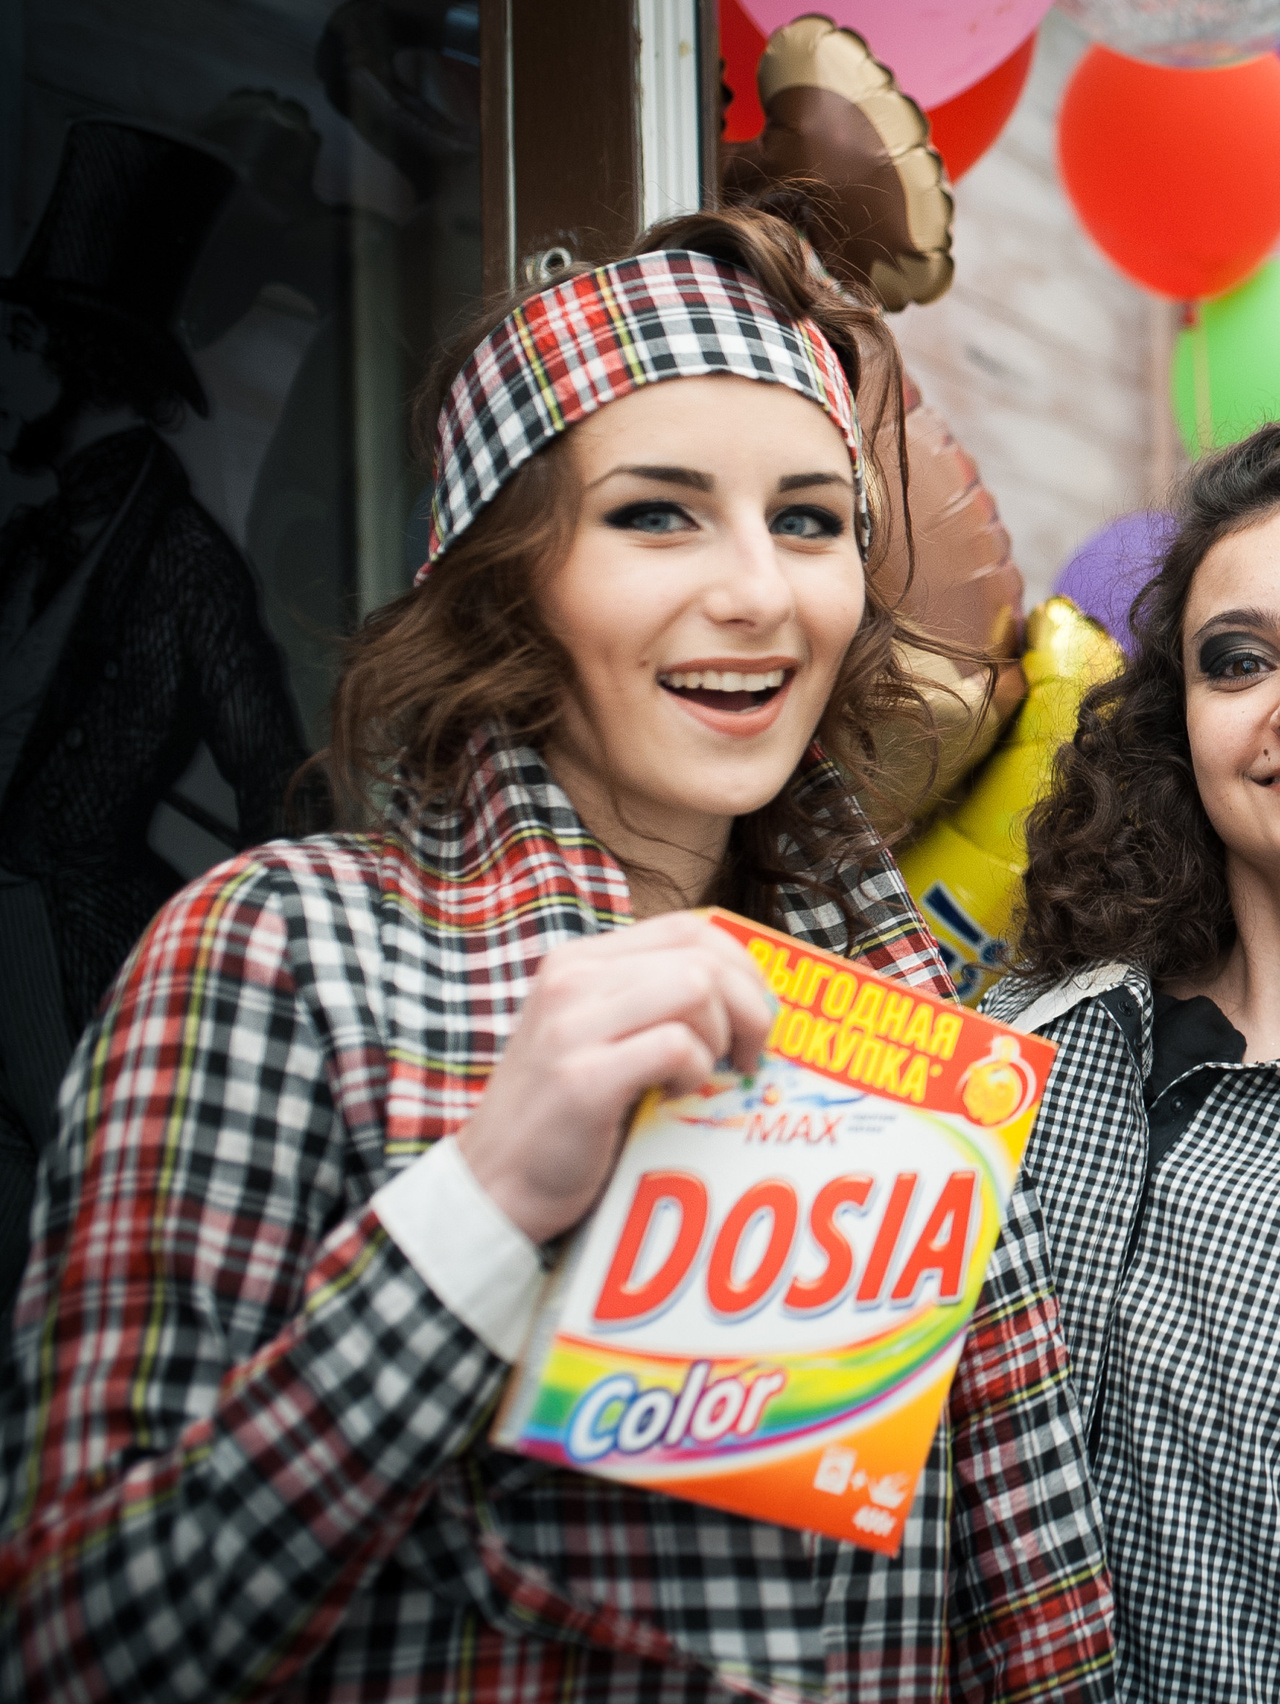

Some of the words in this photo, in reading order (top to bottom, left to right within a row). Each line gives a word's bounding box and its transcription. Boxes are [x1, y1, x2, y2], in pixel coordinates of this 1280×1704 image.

[745, 1113, 843, 1146] MAX
[590, 1167, 979, 1329] DOSIA
[563, 1360, 789, 1463] Color
